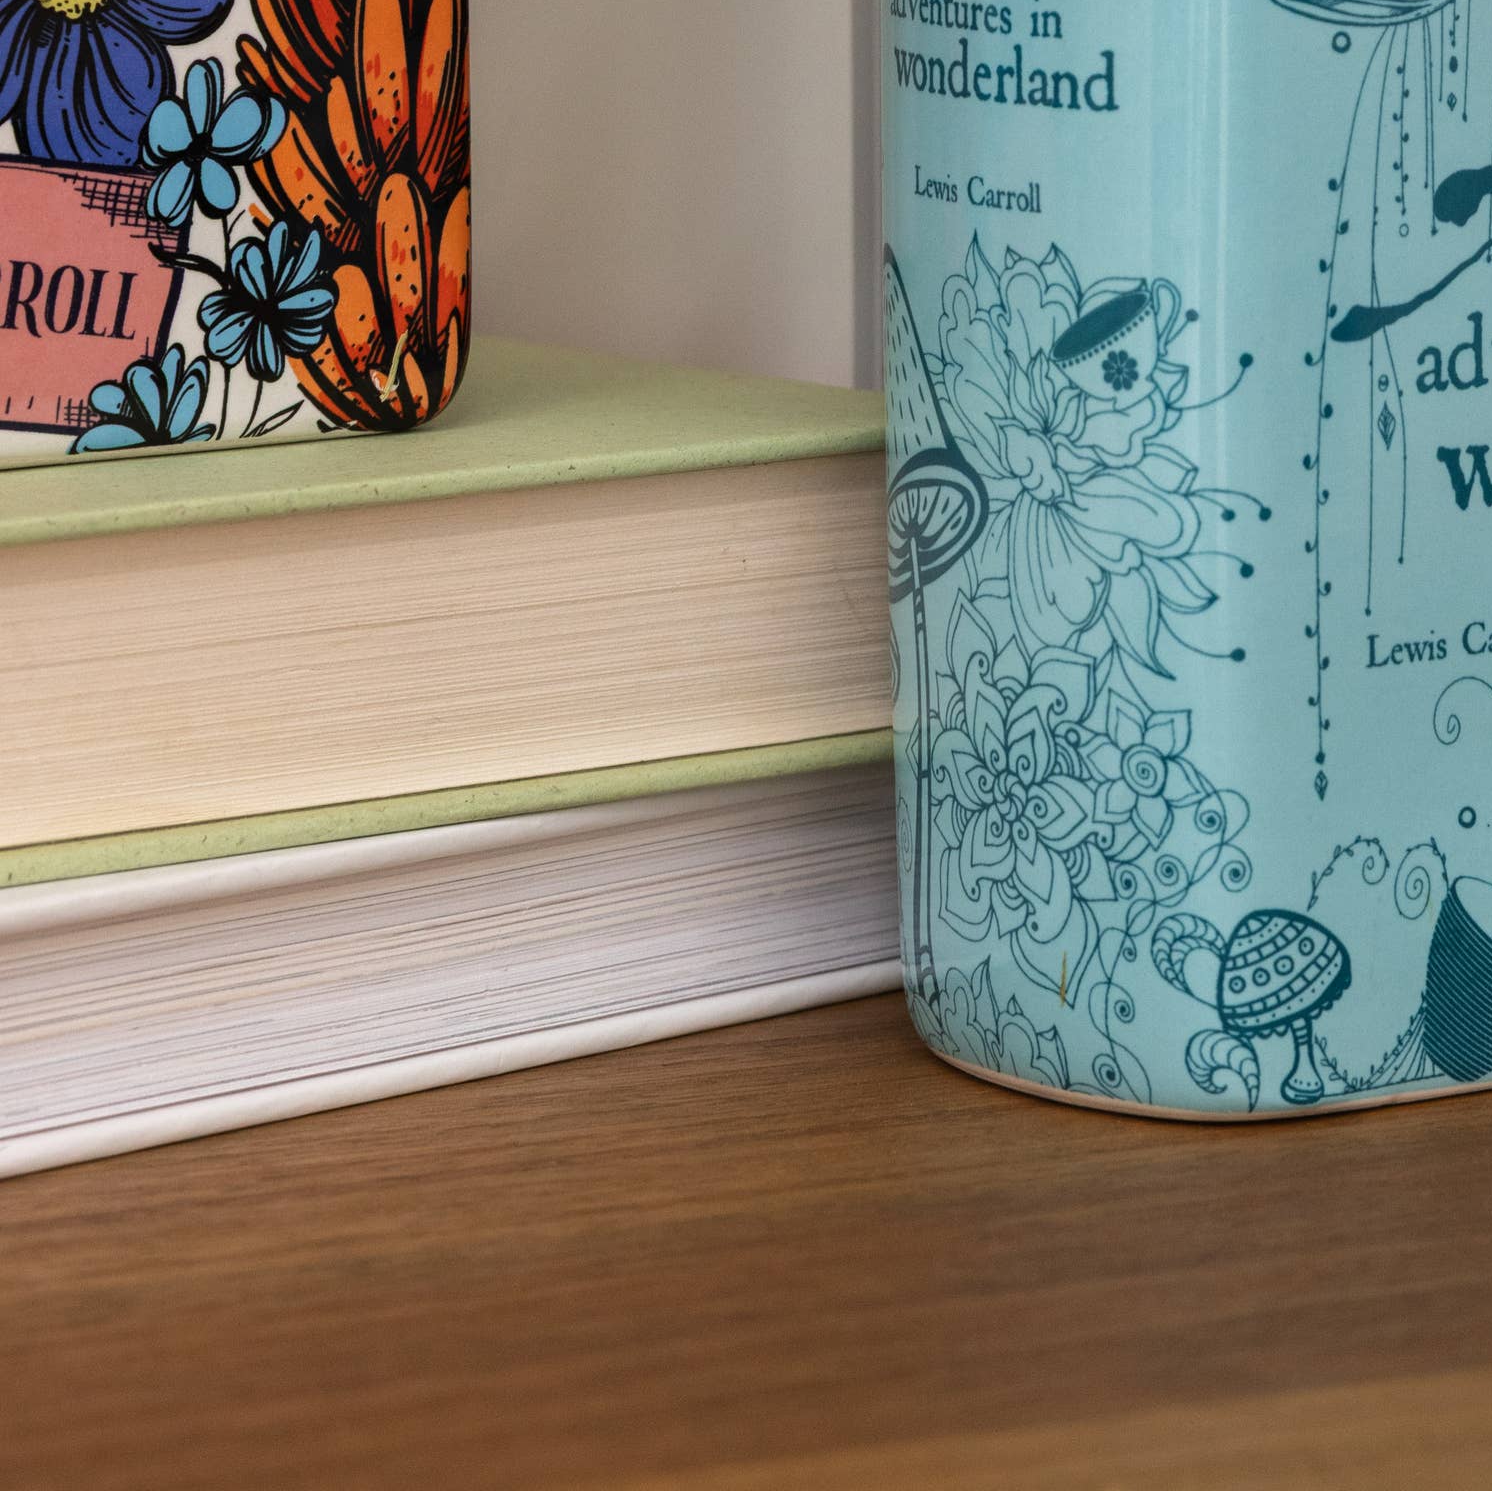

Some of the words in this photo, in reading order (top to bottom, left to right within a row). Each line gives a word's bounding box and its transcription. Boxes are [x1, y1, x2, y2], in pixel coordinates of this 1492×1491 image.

[894, 37, 1120, 113] wonderland
[914, 164, 959, 204] Lewis
[967, 174, 1042, 214] Carroll
[0, 259, 138, 340] ROLL
[1366, 630, 1448, 669] Lewis
